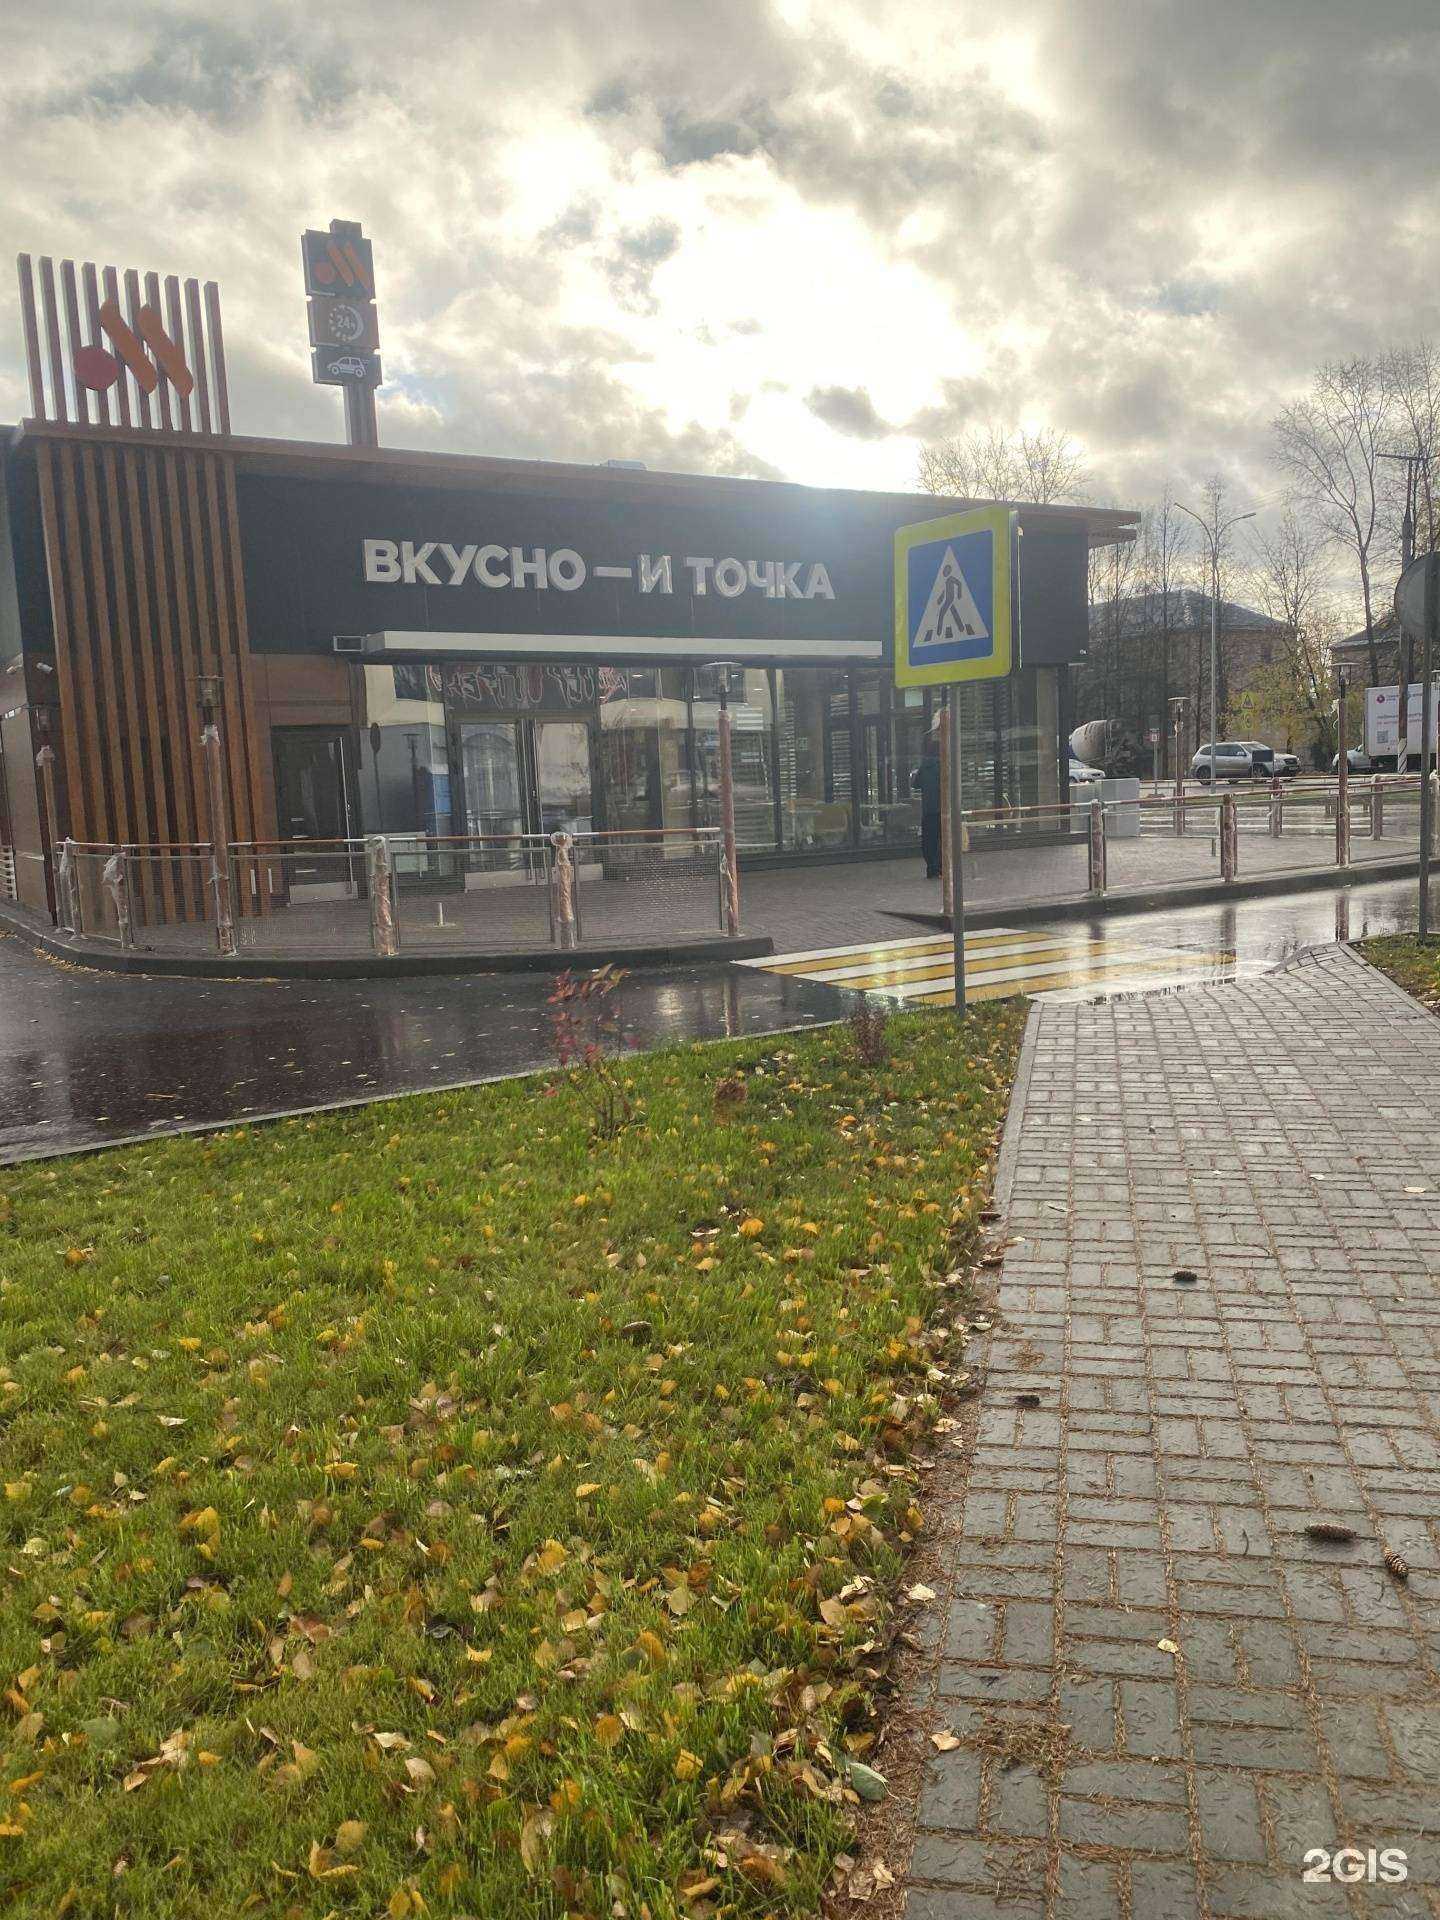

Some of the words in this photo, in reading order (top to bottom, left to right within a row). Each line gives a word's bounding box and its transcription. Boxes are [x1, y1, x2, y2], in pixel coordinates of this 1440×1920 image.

[364, 538, 587, 591] ВКУСНО
[638, 553, 673, 594] И
[684, 556, 837, 600] ТОЧКА
